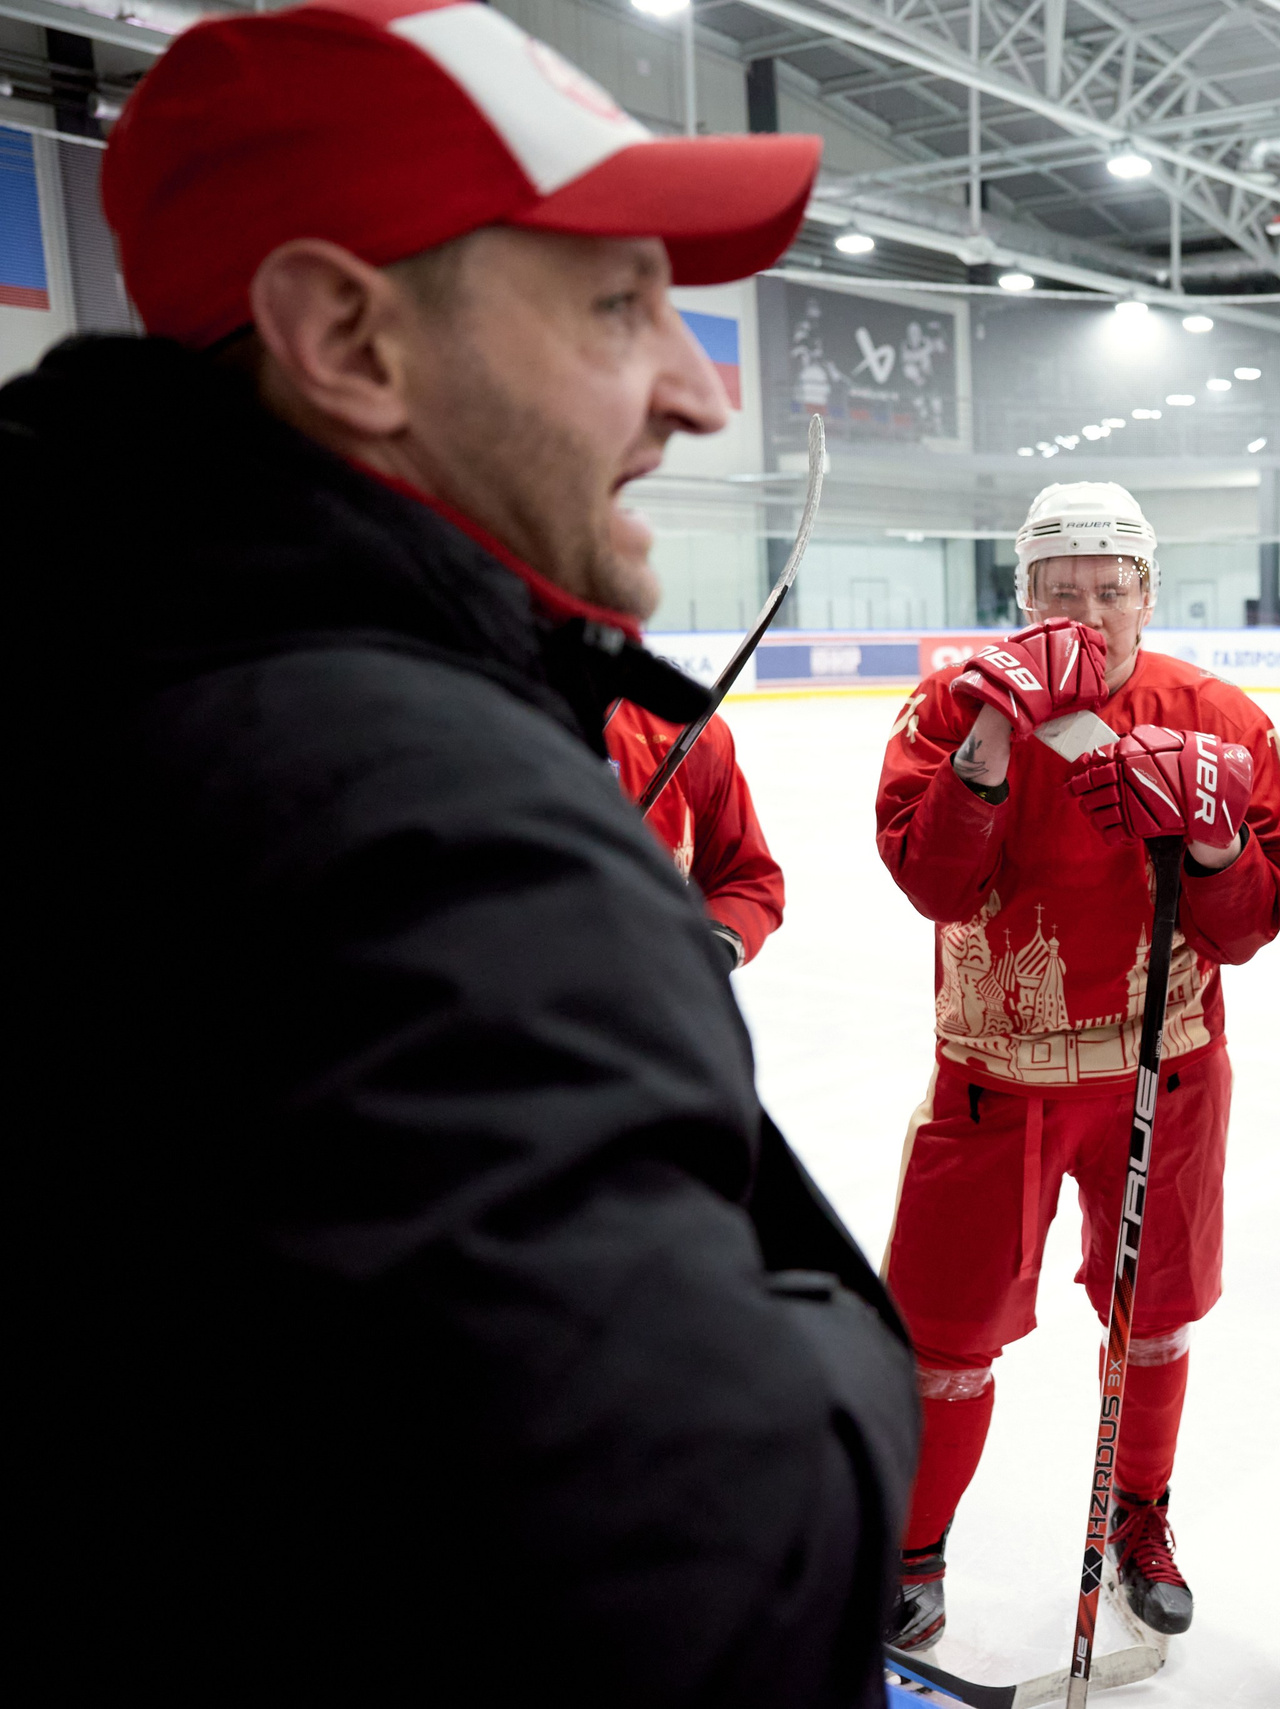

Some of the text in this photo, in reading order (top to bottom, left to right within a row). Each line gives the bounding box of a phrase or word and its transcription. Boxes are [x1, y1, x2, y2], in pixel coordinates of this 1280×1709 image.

[976, 645, 1044, 692] BAU
[1194, 731, 1221, 826] UER
[1115, 1064, 1158, 1281] TRUE
[1087, 1358, 1122, 1541] HZRDUS 3X
[1073, 1635, 1089, 1679] UE
